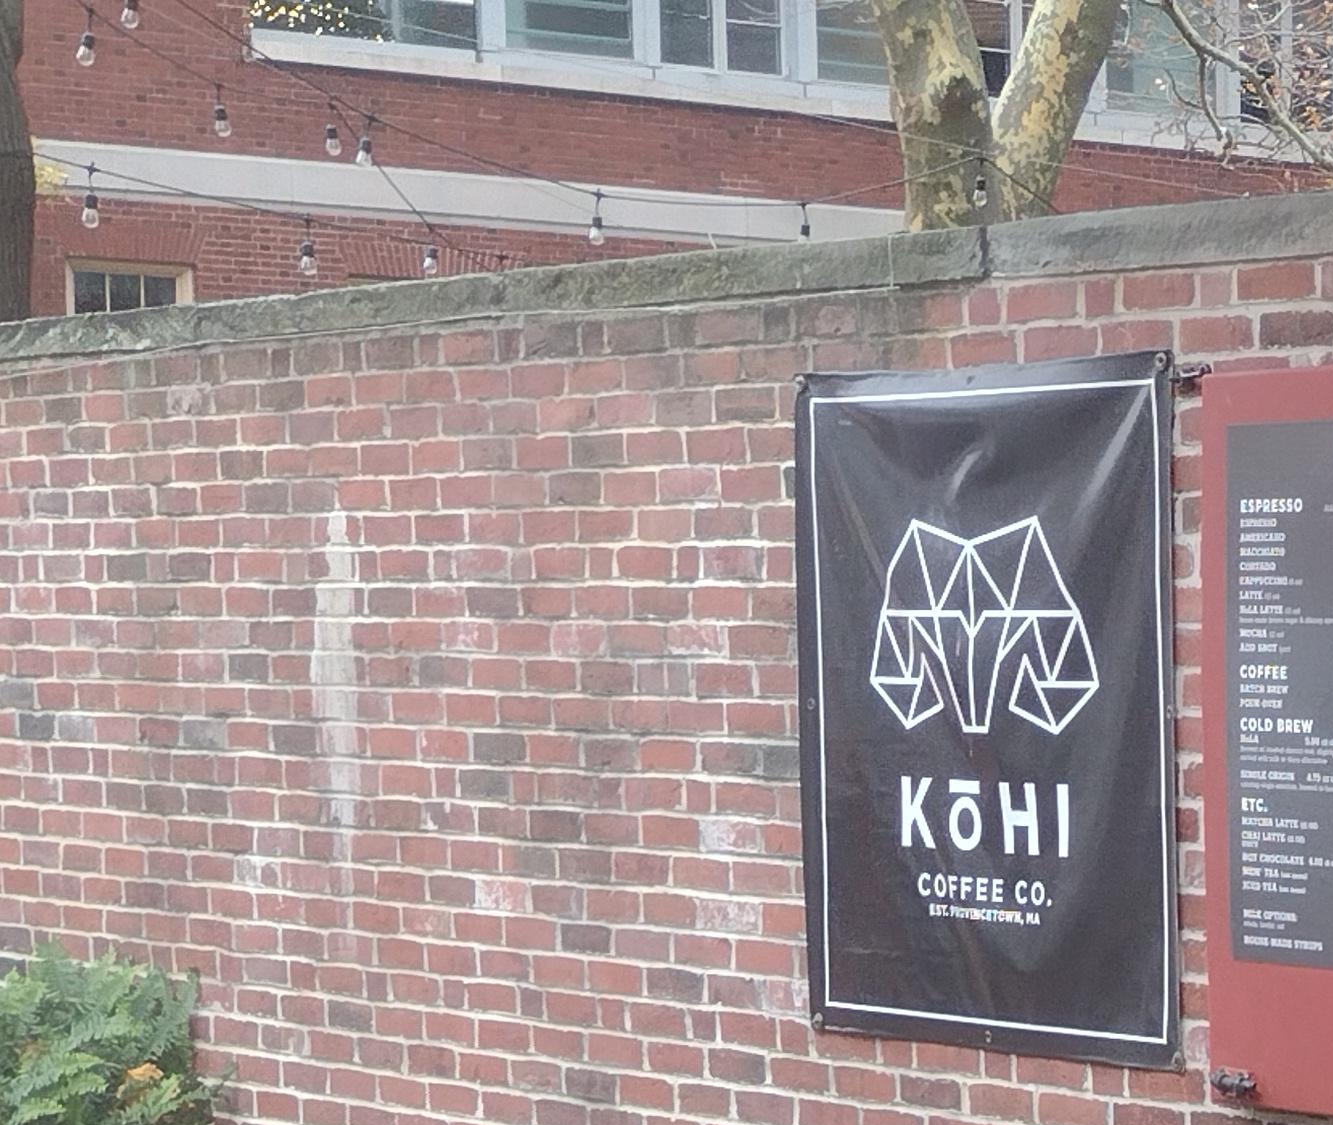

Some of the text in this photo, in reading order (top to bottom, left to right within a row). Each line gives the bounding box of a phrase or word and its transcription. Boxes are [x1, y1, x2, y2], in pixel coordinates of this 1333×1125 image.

[1240, 498, 1303, 513] ESPRESSO
[1239, 590, 1263, 600] LATTE
[1240, 664, 1288, 679] COFFEE
[1240, 717, 1313, 734] COLD BREW
[1241, 797, 1268, 812] ETC.
[1275, 818, 1299, 829] LATTE
[1262, 832, 1286, 843] LATTE
[1259, 853, 1304, 866] CHOCOLATE
[917, 872, 1052, 907] COFFEE CO.
[1262, 882, 1278, 892] TEA
[929, 903, 949, 917] EST.
[1026, 912, 1041, 925] MA
